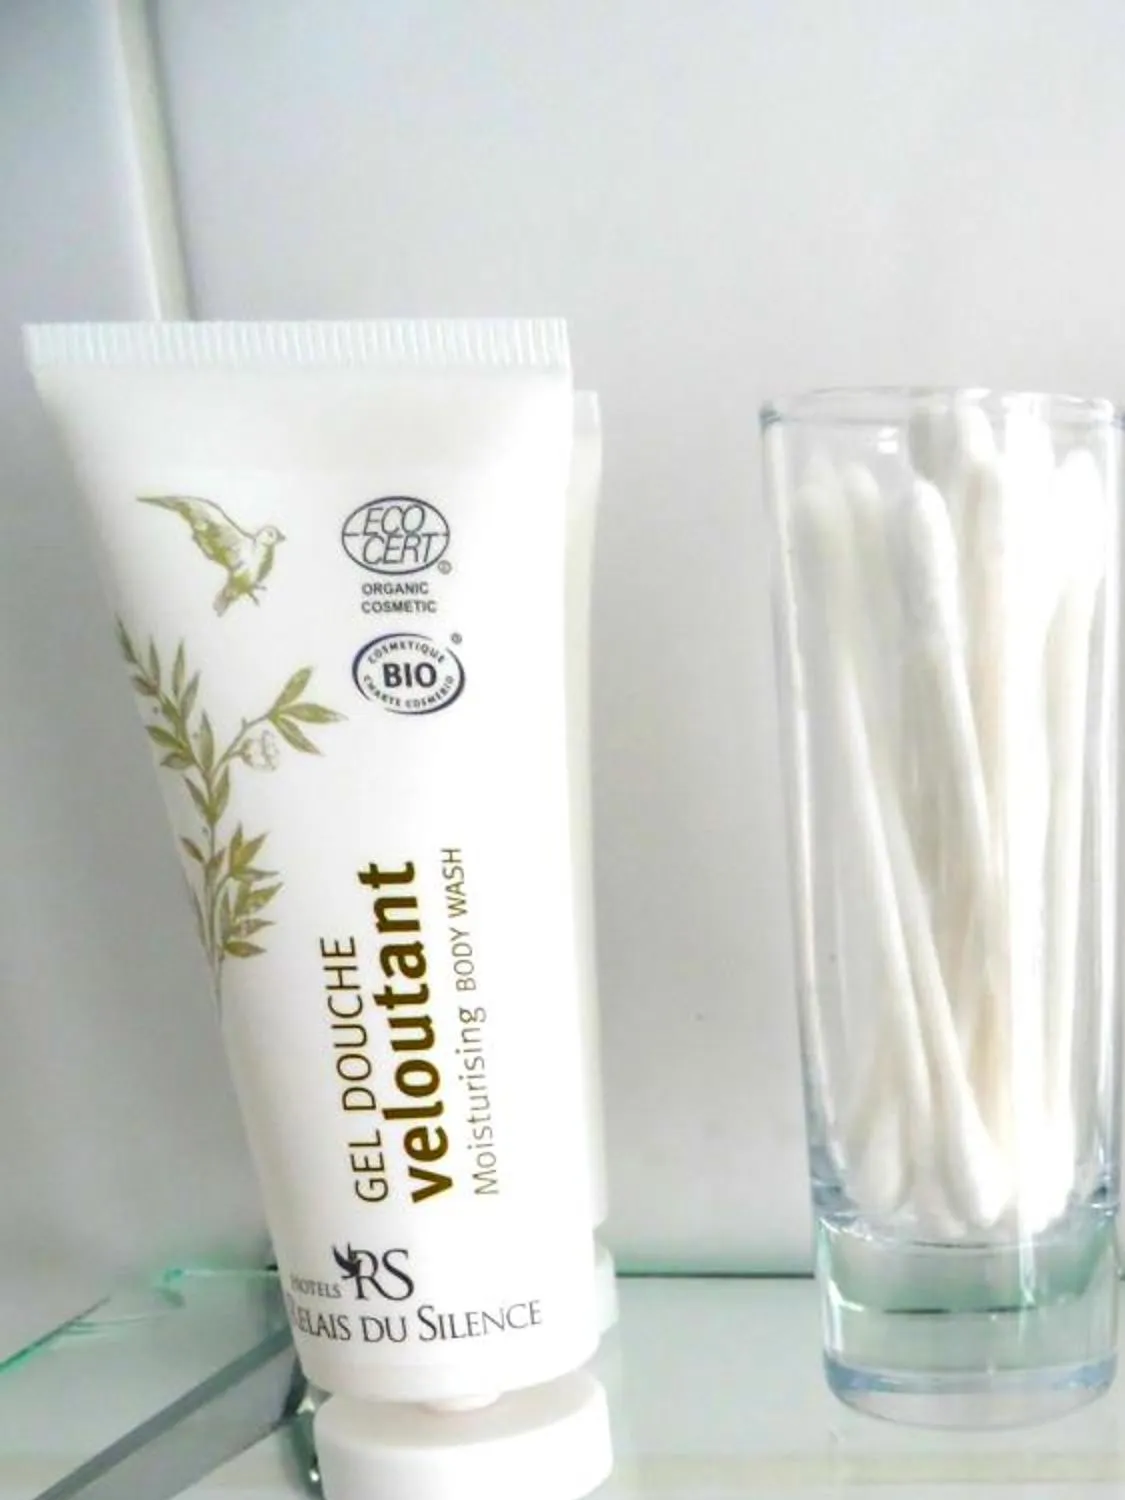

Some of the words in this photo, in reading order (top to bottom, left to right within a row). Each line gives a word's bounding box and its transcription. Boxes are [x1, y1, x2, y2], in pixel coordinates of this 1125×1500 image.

[361, 581, 429, 596] ORGANIC
[361, 600, 437, 614] COSMETIC
[383, 662, 437, 688] BIO
[440, 848, 468, 918] WASH
[449, 927, 477, 992] BODY
[319, 936, 377, 1111] DOUCHE
[357, 860, 453, 1204] veloutant
[455, 1006, 499, 1195] Moisturising
[348, 1129, 389, 1203] GEL
[352, 1248, 415, 1301] RS
[359, 1315, 408, 1343] DU
[416, 1300, 543, 1342] SILENCE
